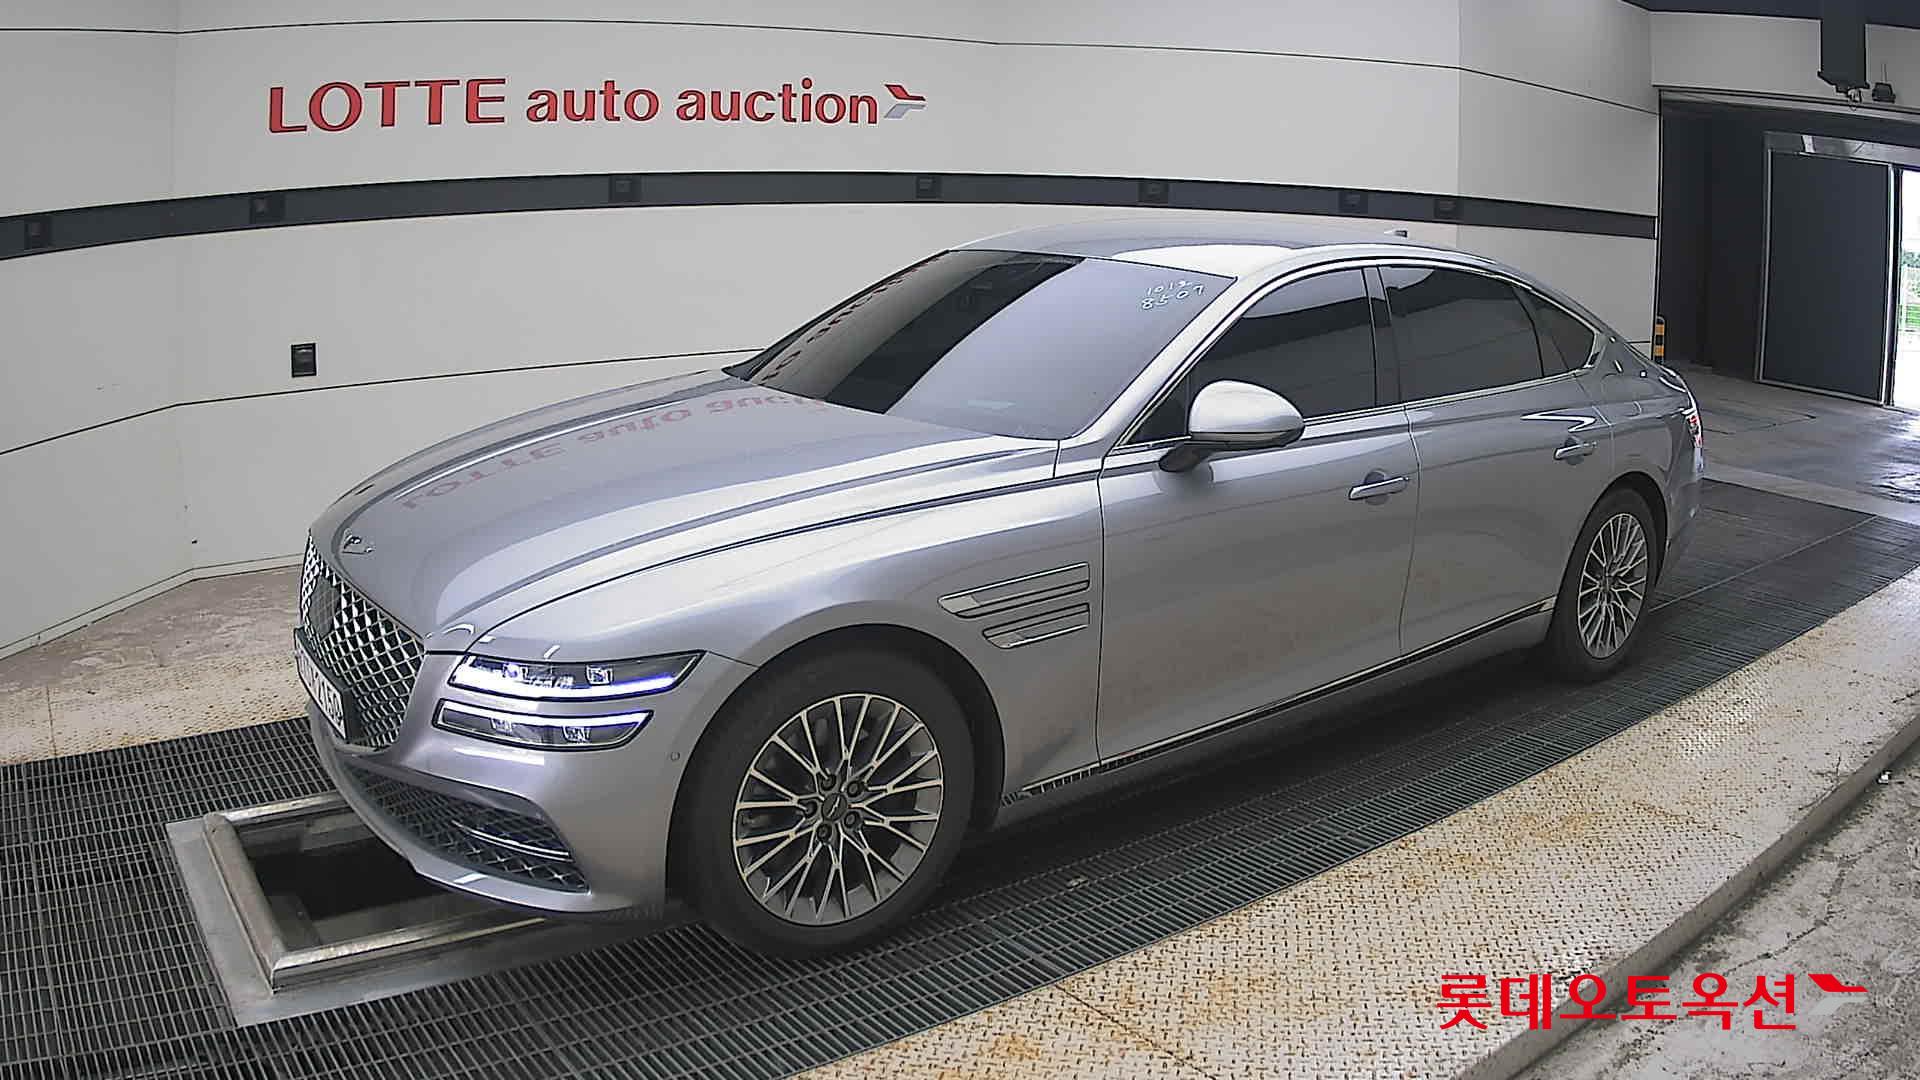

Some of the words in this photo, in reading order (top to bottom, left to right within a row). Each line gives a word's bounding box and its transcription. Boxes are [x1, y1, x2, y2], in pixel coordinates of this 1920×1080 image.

[268, 79, 505, 134] LOTTE
[526, 80, 660, 123] auto
[676, 78, 878, 124] auction
